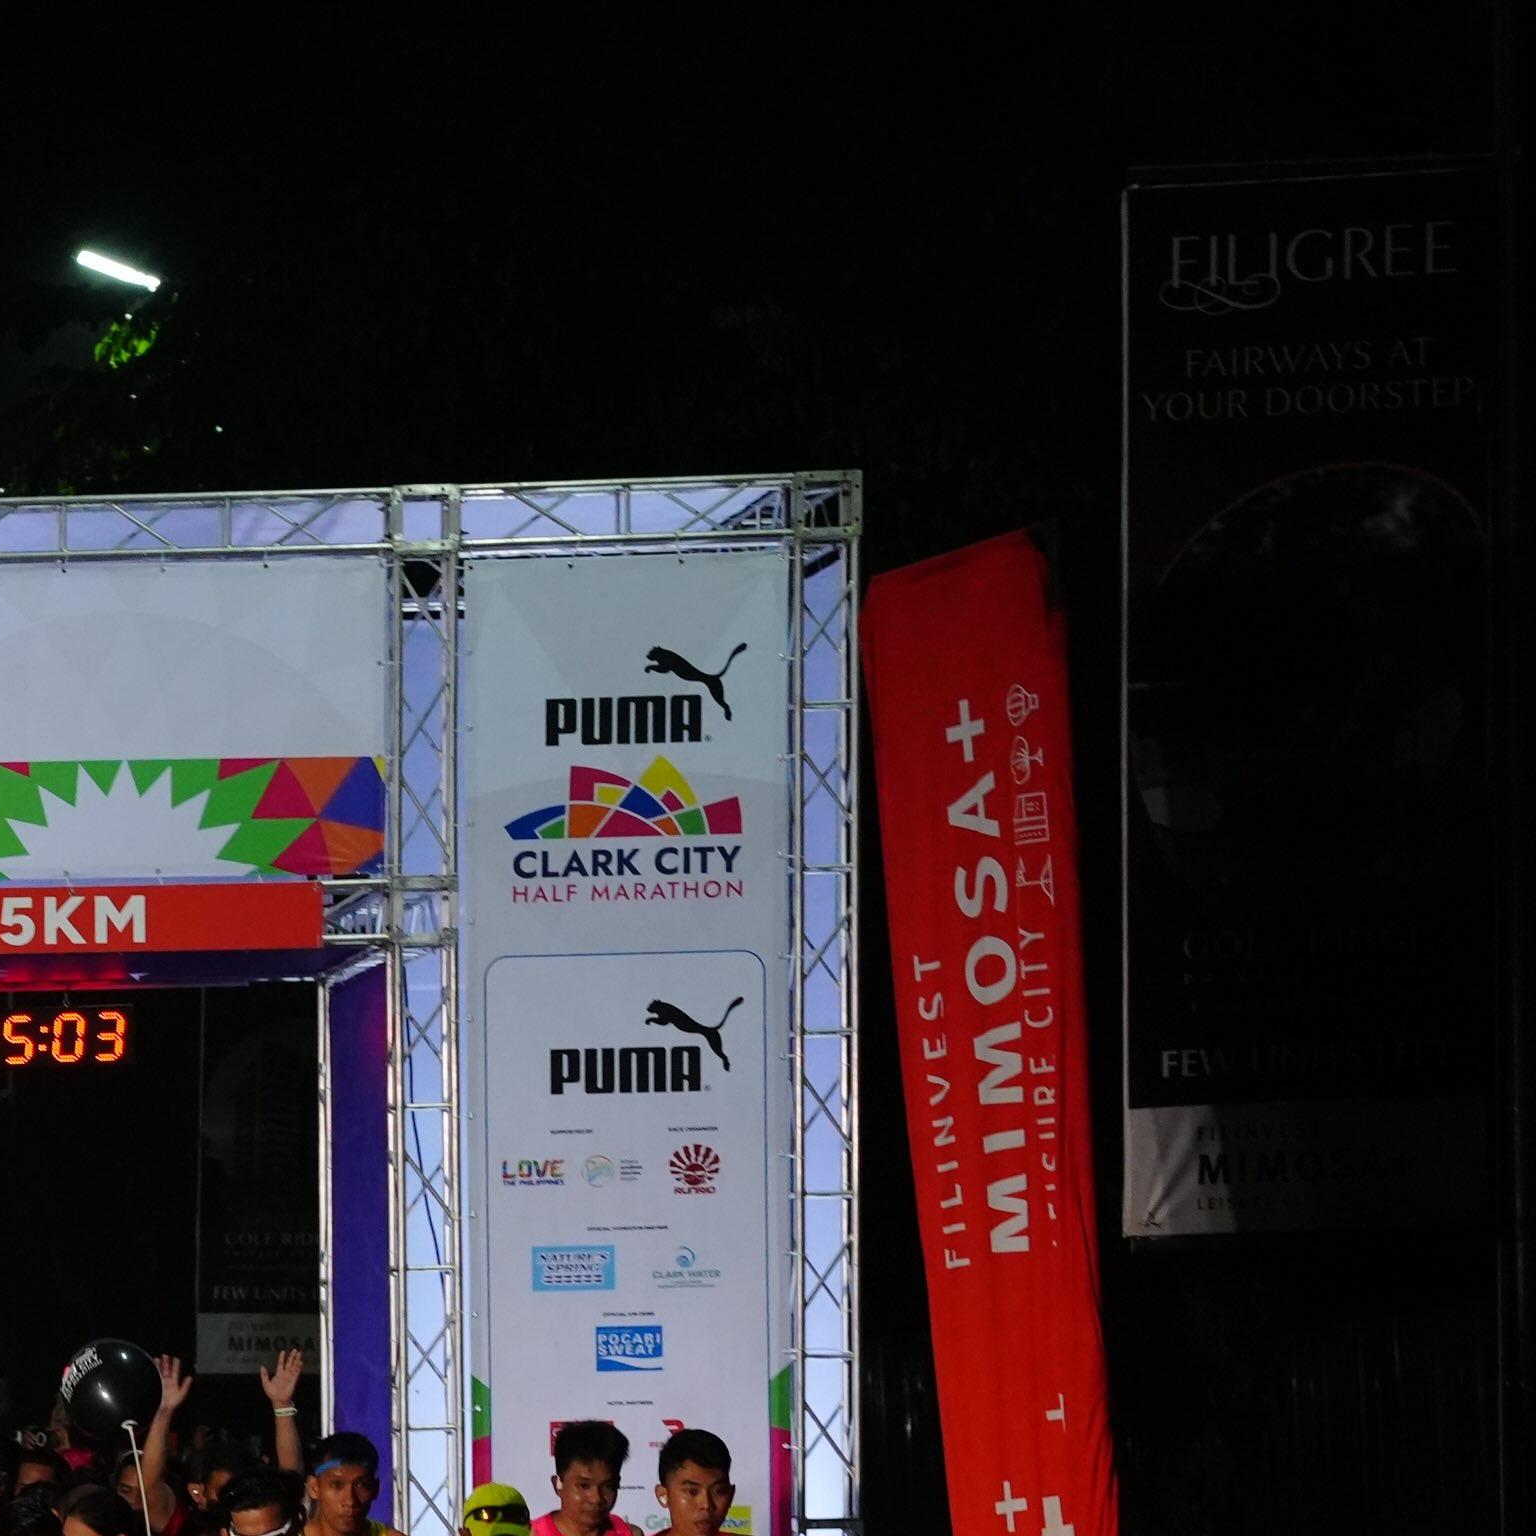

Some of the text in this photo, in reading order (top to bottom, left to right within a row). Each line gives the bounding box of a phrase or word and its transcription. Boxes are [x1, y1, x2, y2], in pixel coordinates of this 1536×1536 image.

[1171, 220, 1458, 290] FILIGREE
[1185, 336, 1434, 380] FAIRWAYS AT
[1142, 375, 1475, 423] YOUR DOORSTEP
[544, 694, 703, 746] PUMA
[512, 845, 742, 880] CLARK CITY
[511, 879, 744, 903] HALF MARATHON
[1019, 926, 1054, 1029] CITY
[549, 1045, 701, 1095] PUMA
[1160, 1046, 1237, 1080] FEW
[913, 955, 971, 1270] FILINVEST
[501, 1159, 566, 1179] LOVE
[597, 1332, 661, 1346] POCARI
[597, 1343, 655, 1356] SWEAT
